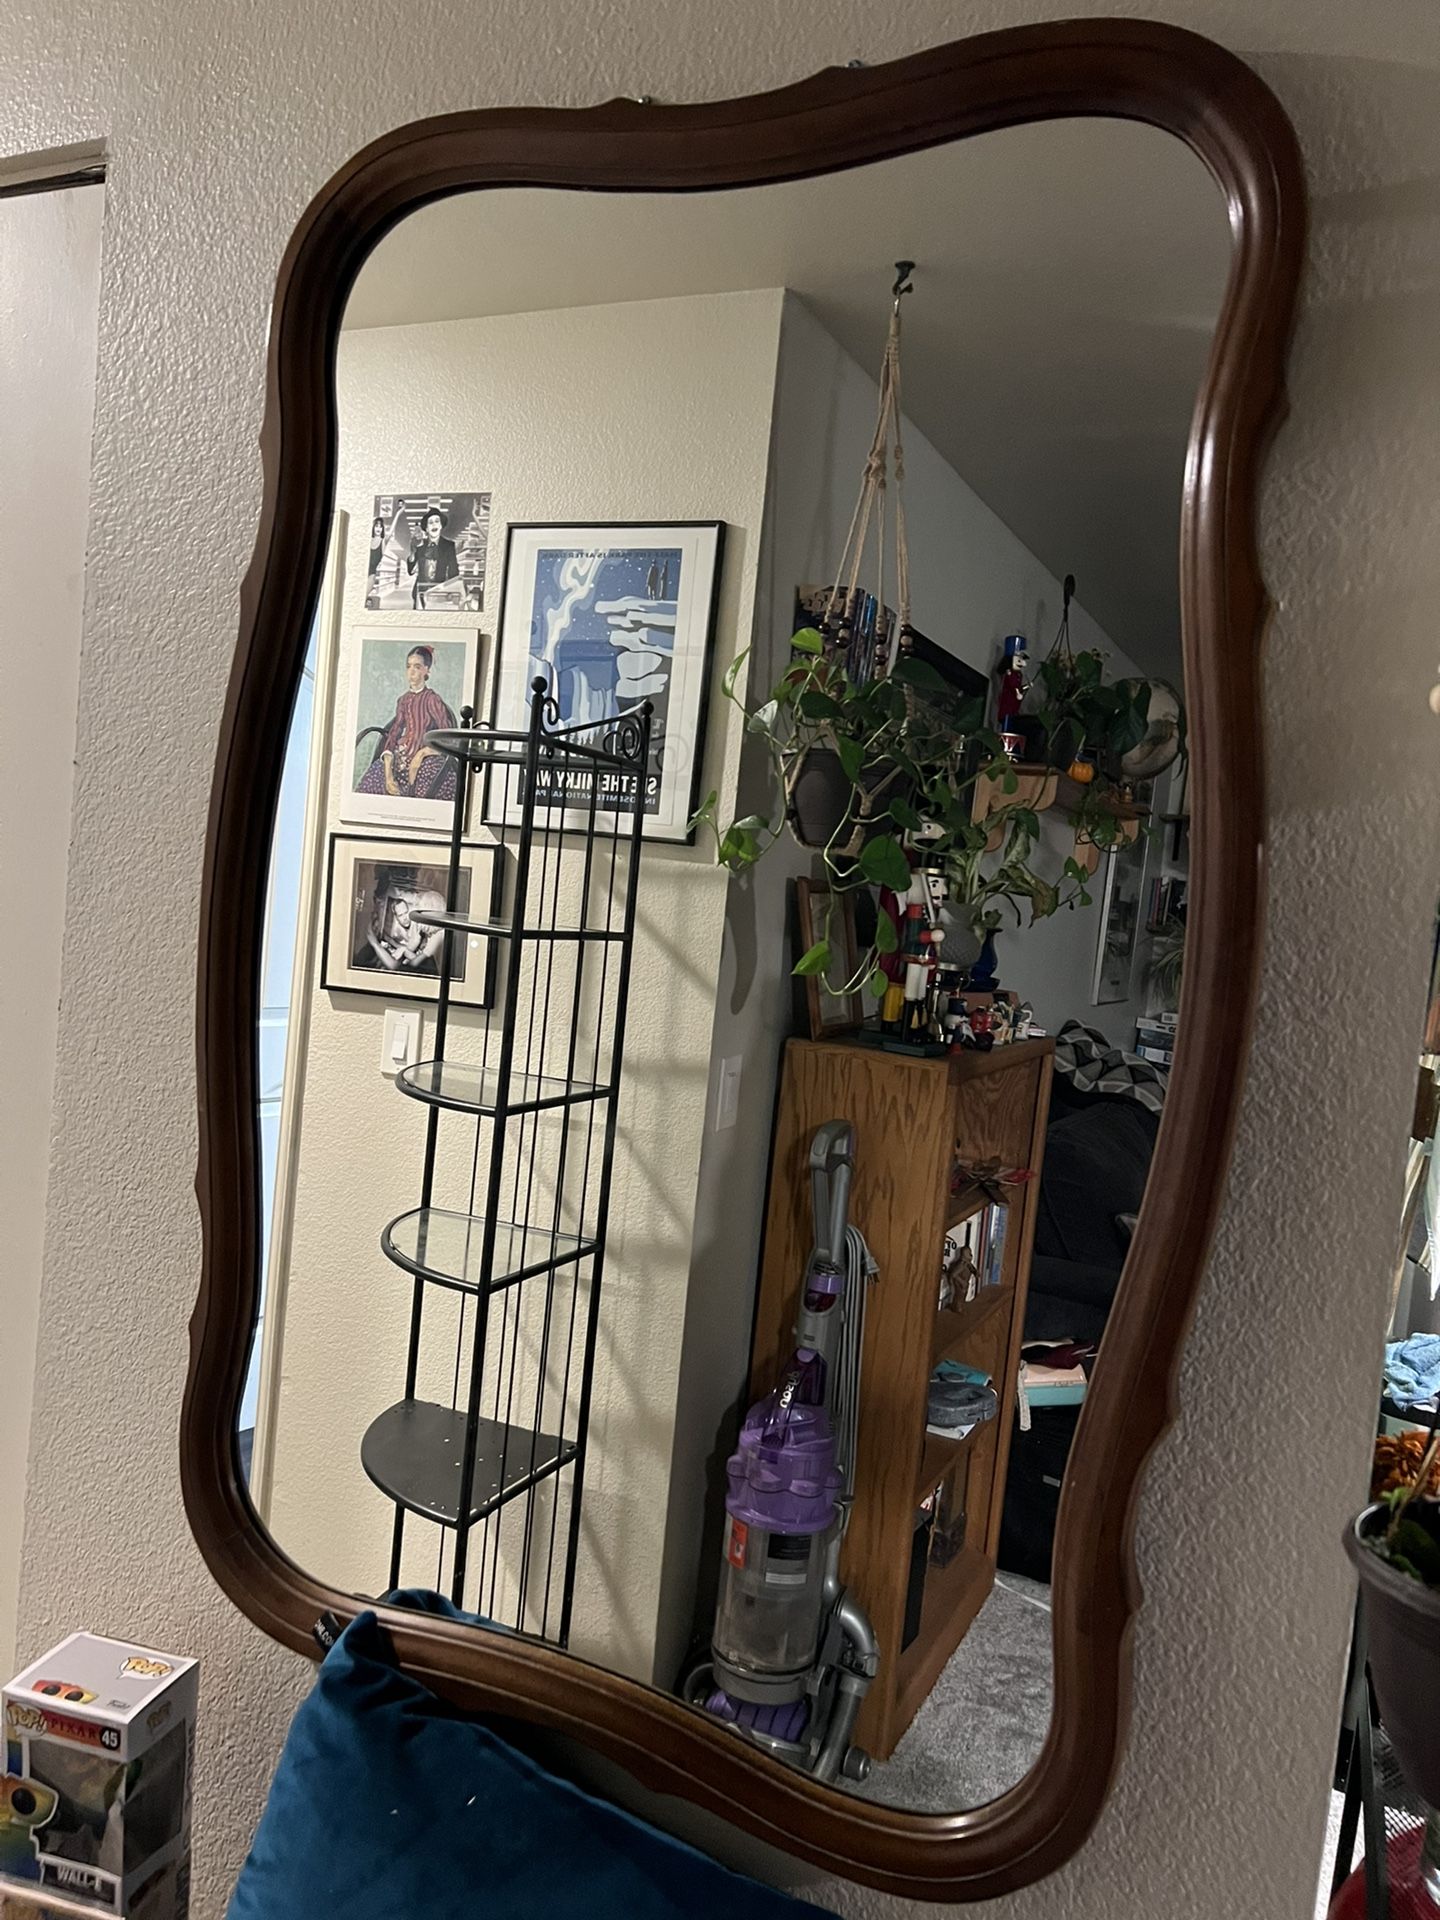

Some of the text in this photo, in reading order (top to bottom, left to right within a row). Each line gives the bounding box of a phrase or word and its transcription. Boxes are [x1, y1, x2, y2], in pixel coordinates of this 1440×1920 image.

[7, 1703, 48, 1733] POP!
[51, 1719, 96, 1739] PIXAR
[101, 1730, 118, 1747] 45
